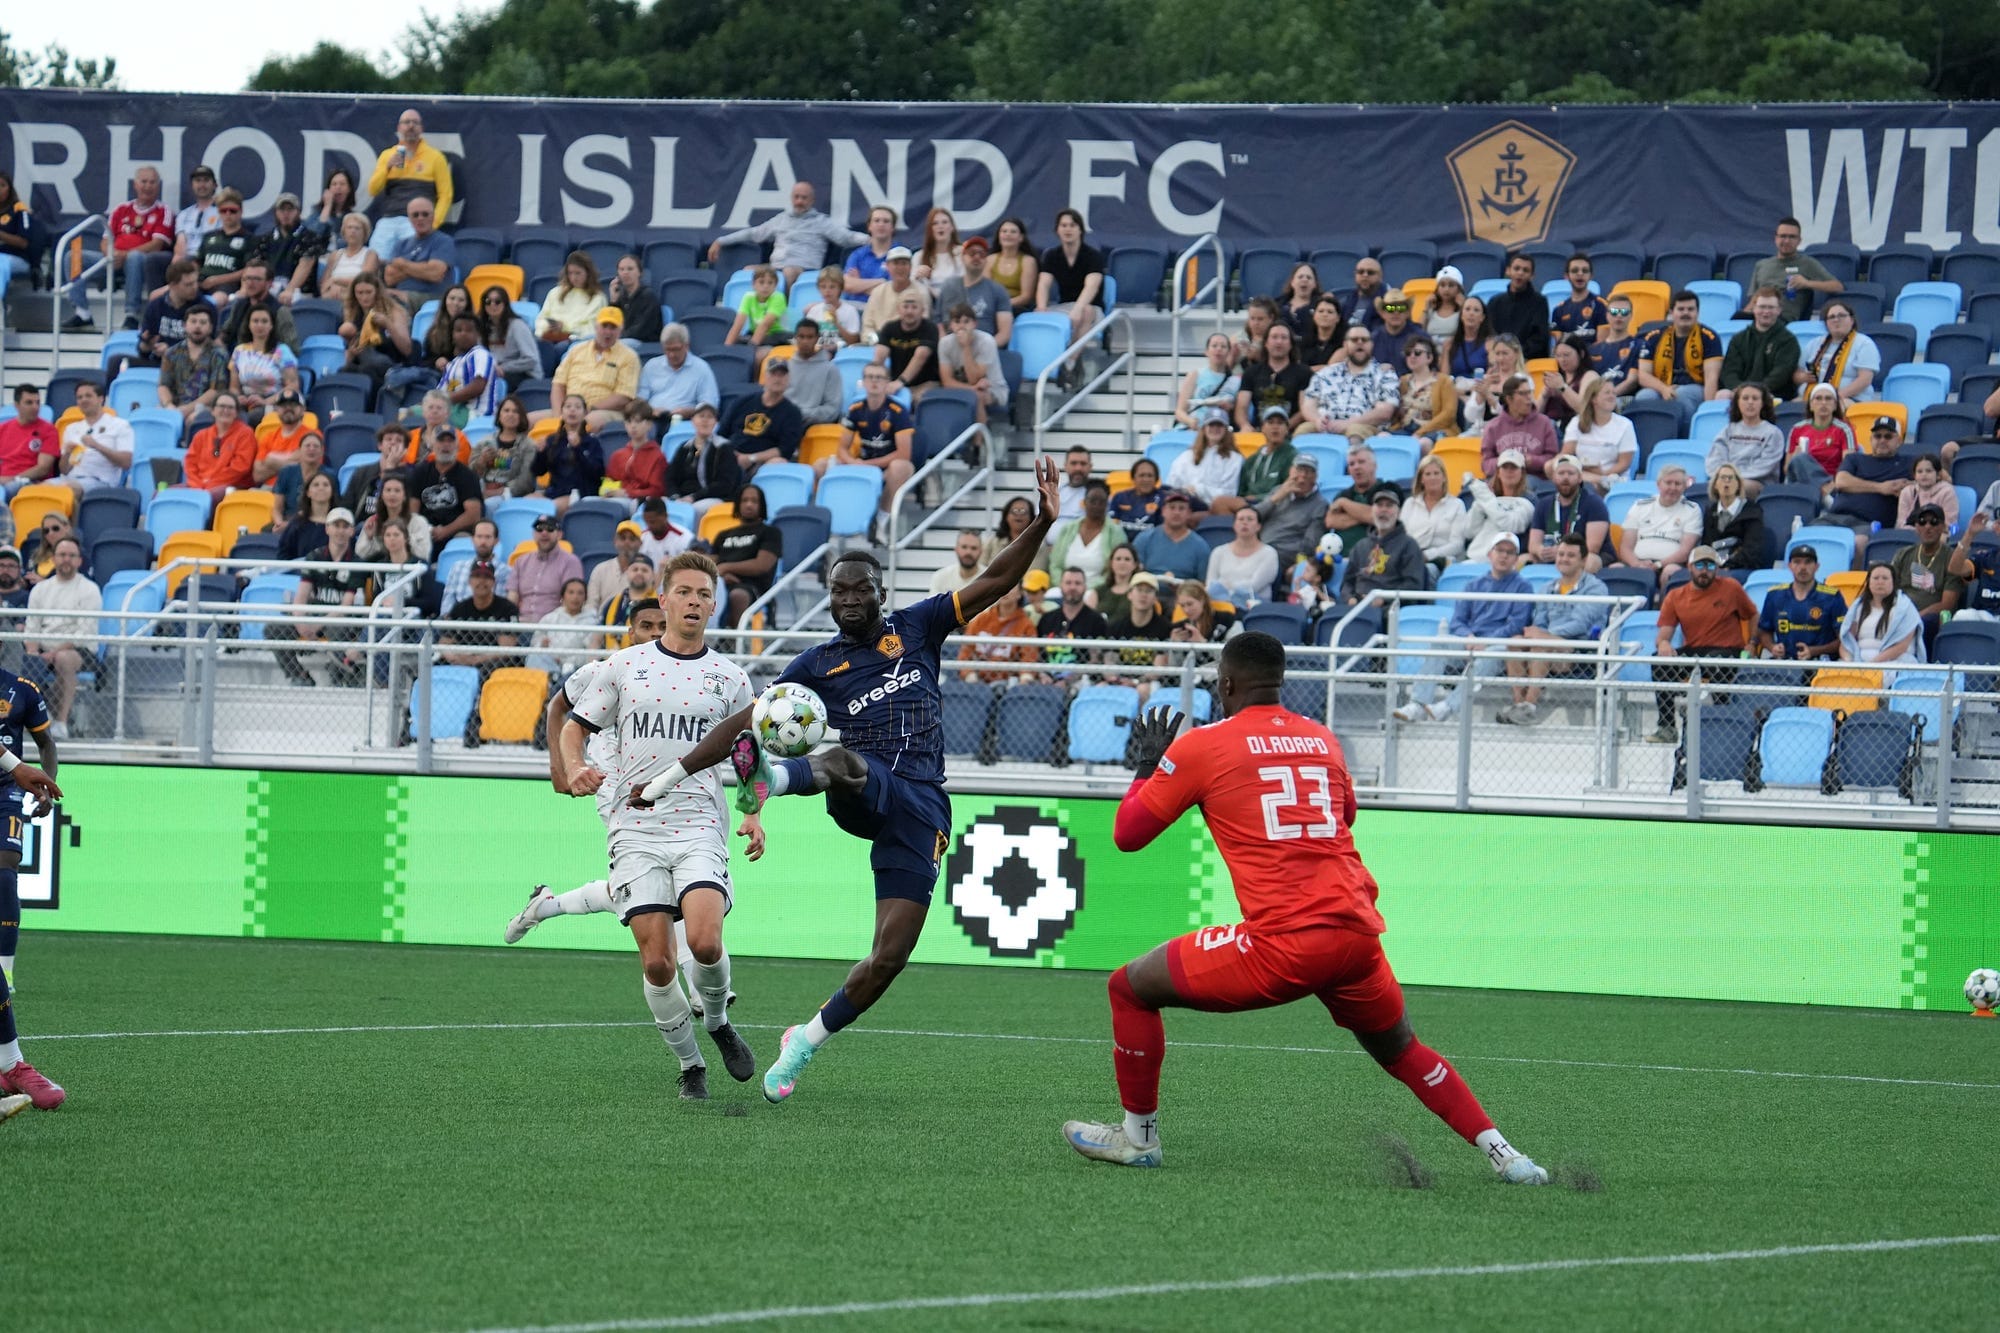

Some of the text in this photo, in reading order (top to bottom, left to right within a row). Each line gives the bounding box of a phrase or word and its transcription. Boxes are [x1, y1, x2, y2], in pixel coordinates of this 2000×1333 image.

[515, 133, 1013, 231] ISLAND
[1067, 140, 1226, 236] FC
[1246, 735, 1329, 754] OLADAPO
[1258, 766, 1337, 841] 23
